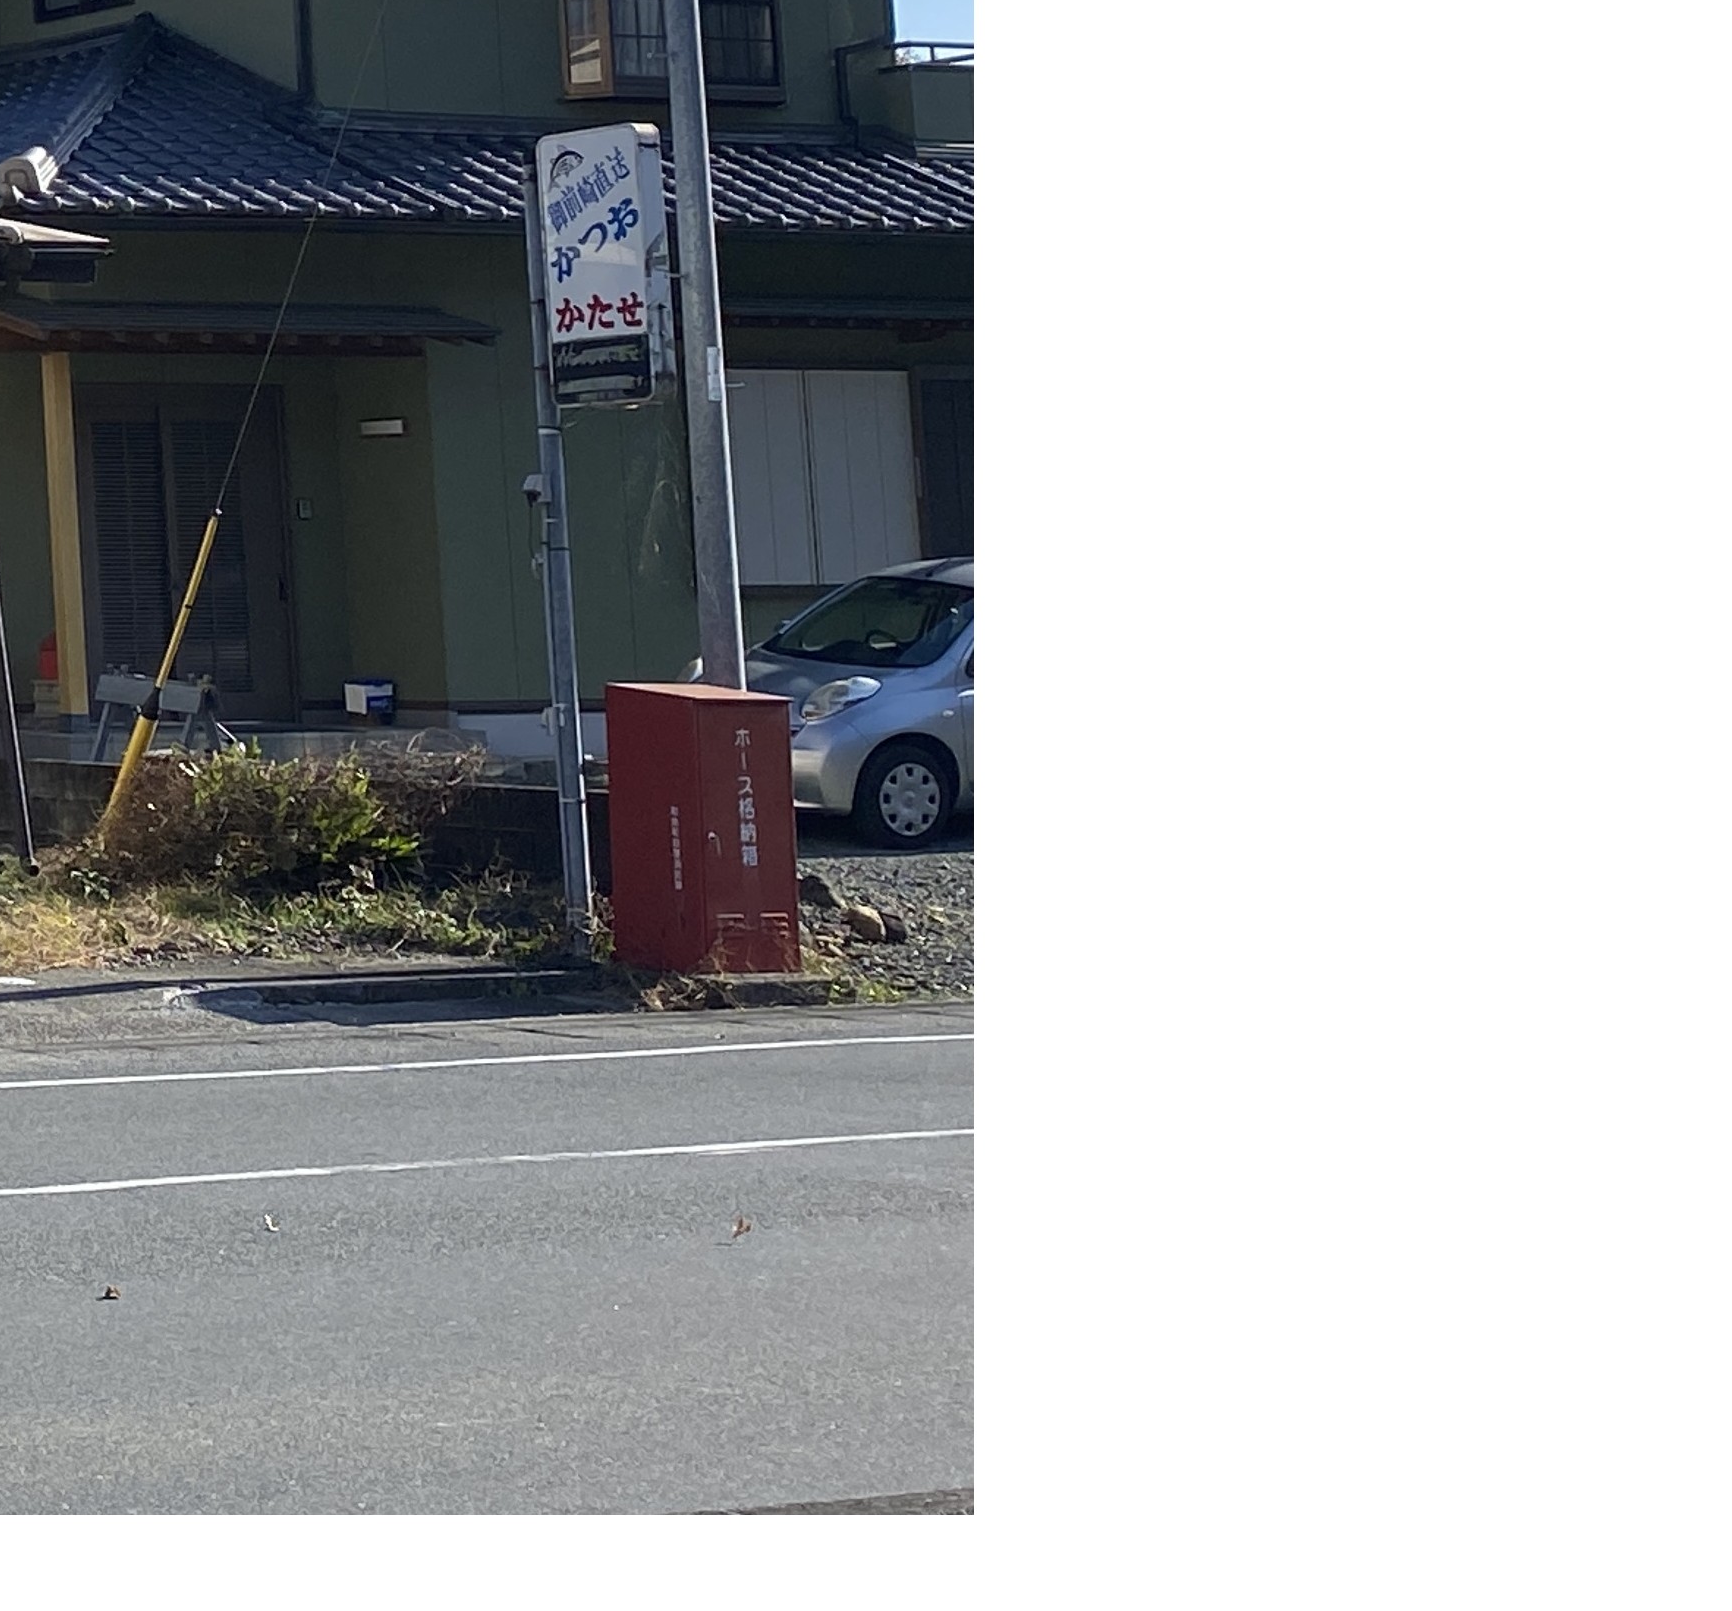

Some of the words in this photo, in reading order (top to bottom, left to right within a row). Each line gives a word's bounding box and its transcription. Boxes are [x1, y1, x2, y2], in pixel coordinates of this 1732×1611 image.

[550, 197, 639, 283] かつお
[555, 291, 645, 333] かたせ
[733, 727, 759, 868] ホース格納箱
